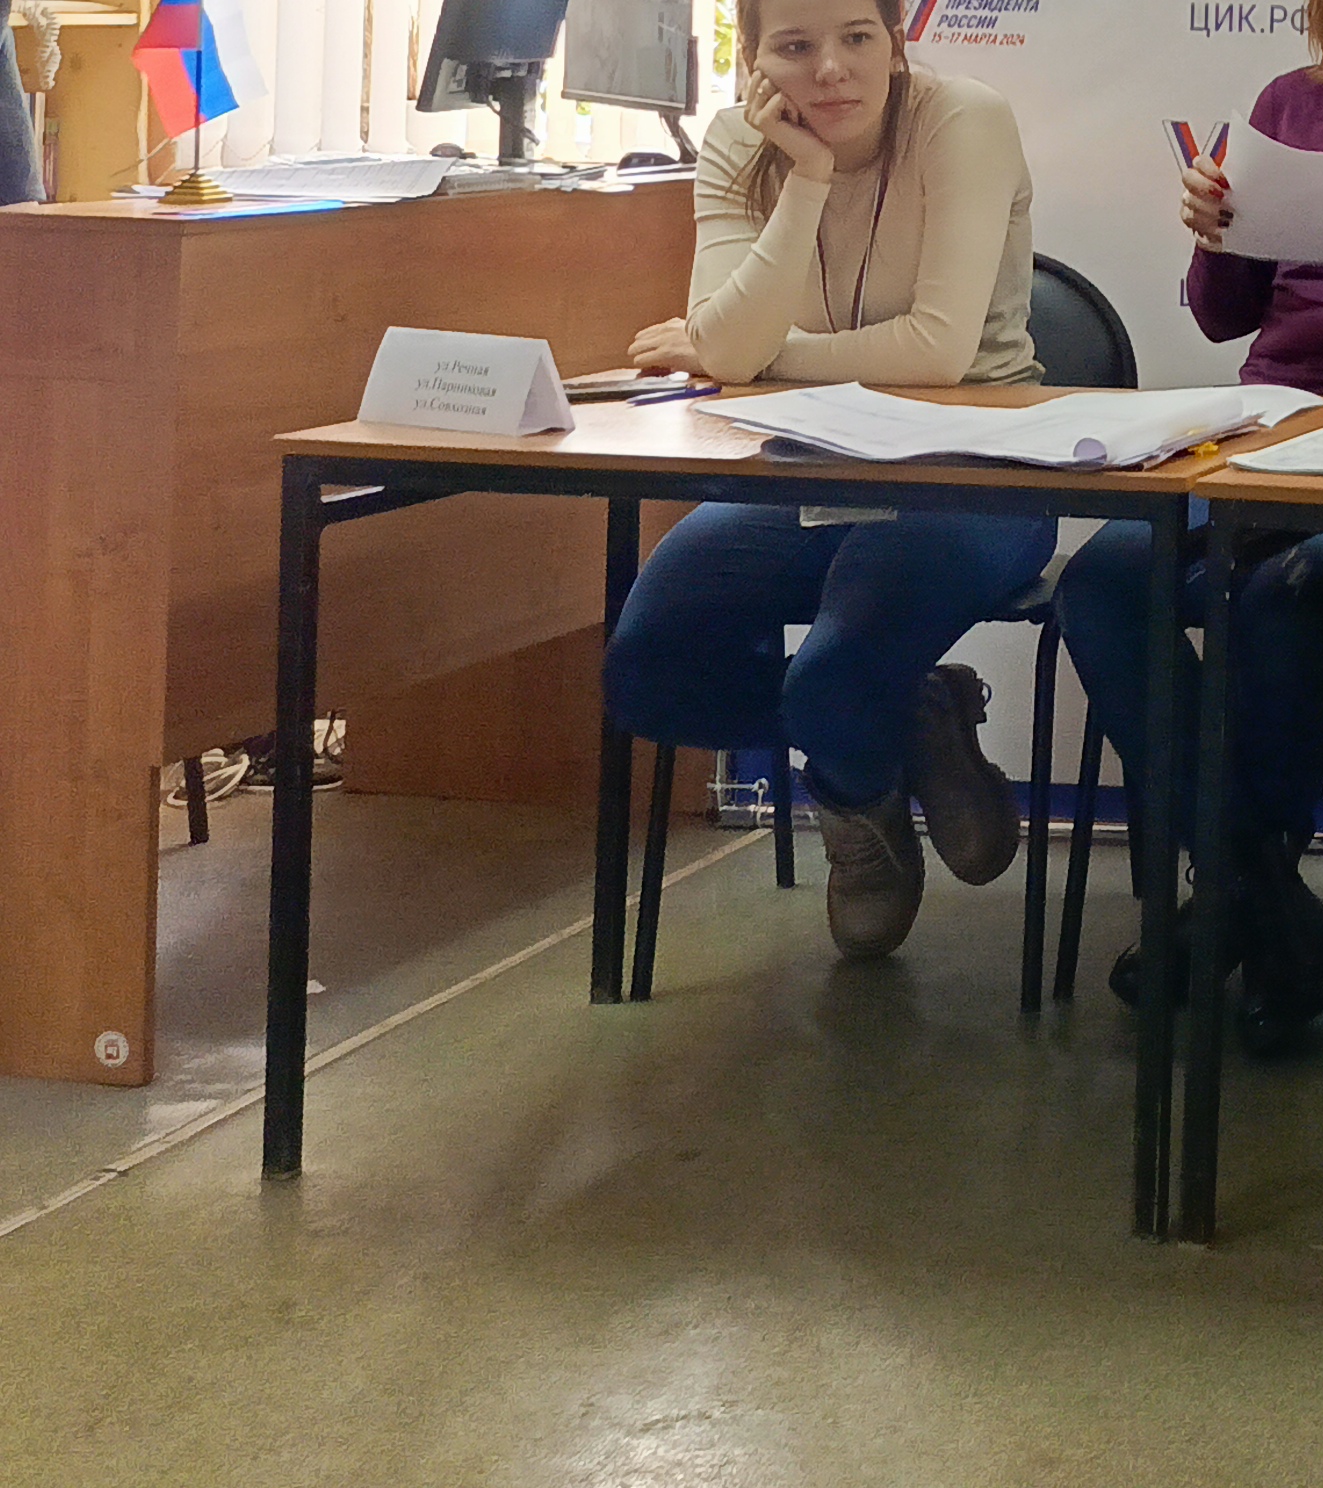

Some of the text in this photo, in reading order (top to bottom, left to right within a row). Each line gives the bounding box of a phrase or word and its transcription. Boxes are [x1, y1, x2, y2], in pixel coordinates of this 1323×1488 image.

[937, 14, 999, 30] РОССИИ
[1190, 2, 1309, 38] ЦИК.РФ
[961, 33, 998, 45] МАРТА
[998, 34, 1026, 47] 2024
